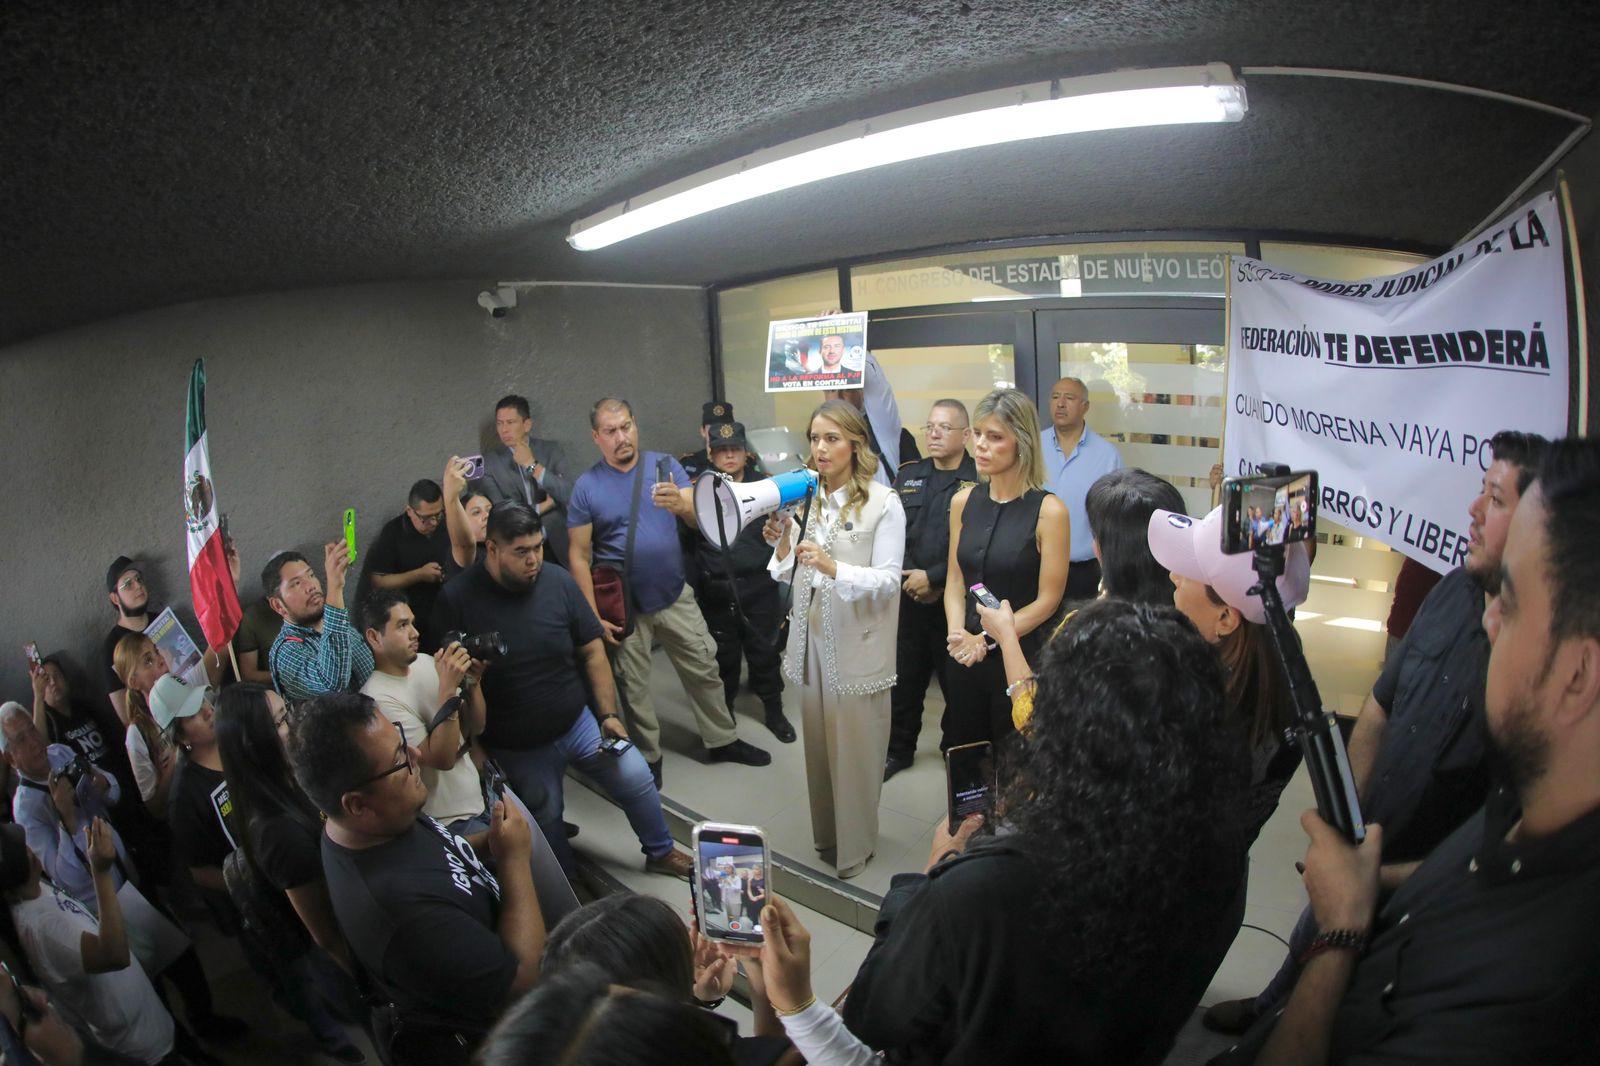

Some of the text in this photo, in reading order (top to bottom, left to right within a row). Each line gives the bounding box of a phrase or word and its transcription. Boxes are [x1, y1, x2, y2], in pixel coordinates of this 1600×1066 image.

[876, 268, 963, 294] CONGRESO
[969, 263, 1002, 284] DEL
[1007, 258, 1078, 283] ESTADO
[1084, 260, 1108, 279] DE
[1114, 258, 1180, 279] NUEVO
[1186, 254, 1225, 279] LEÓ
[1301, 279, 1372, 297] PODER
[1372, 253, 1464, 298] JUDICIAL
[1509, 209, 1550, 250] LA
[1241, 322, 1549, 370] FEDERACIÓN TE DEFENDERÁ
[1235, 393, 1495, 472] CUANDO MORENA VAYA PO
[1322, 486, 1383, 529] RROS
[1389, 506, 1403, 535] Y
[1404, 514, 1470, 567] LIBER
